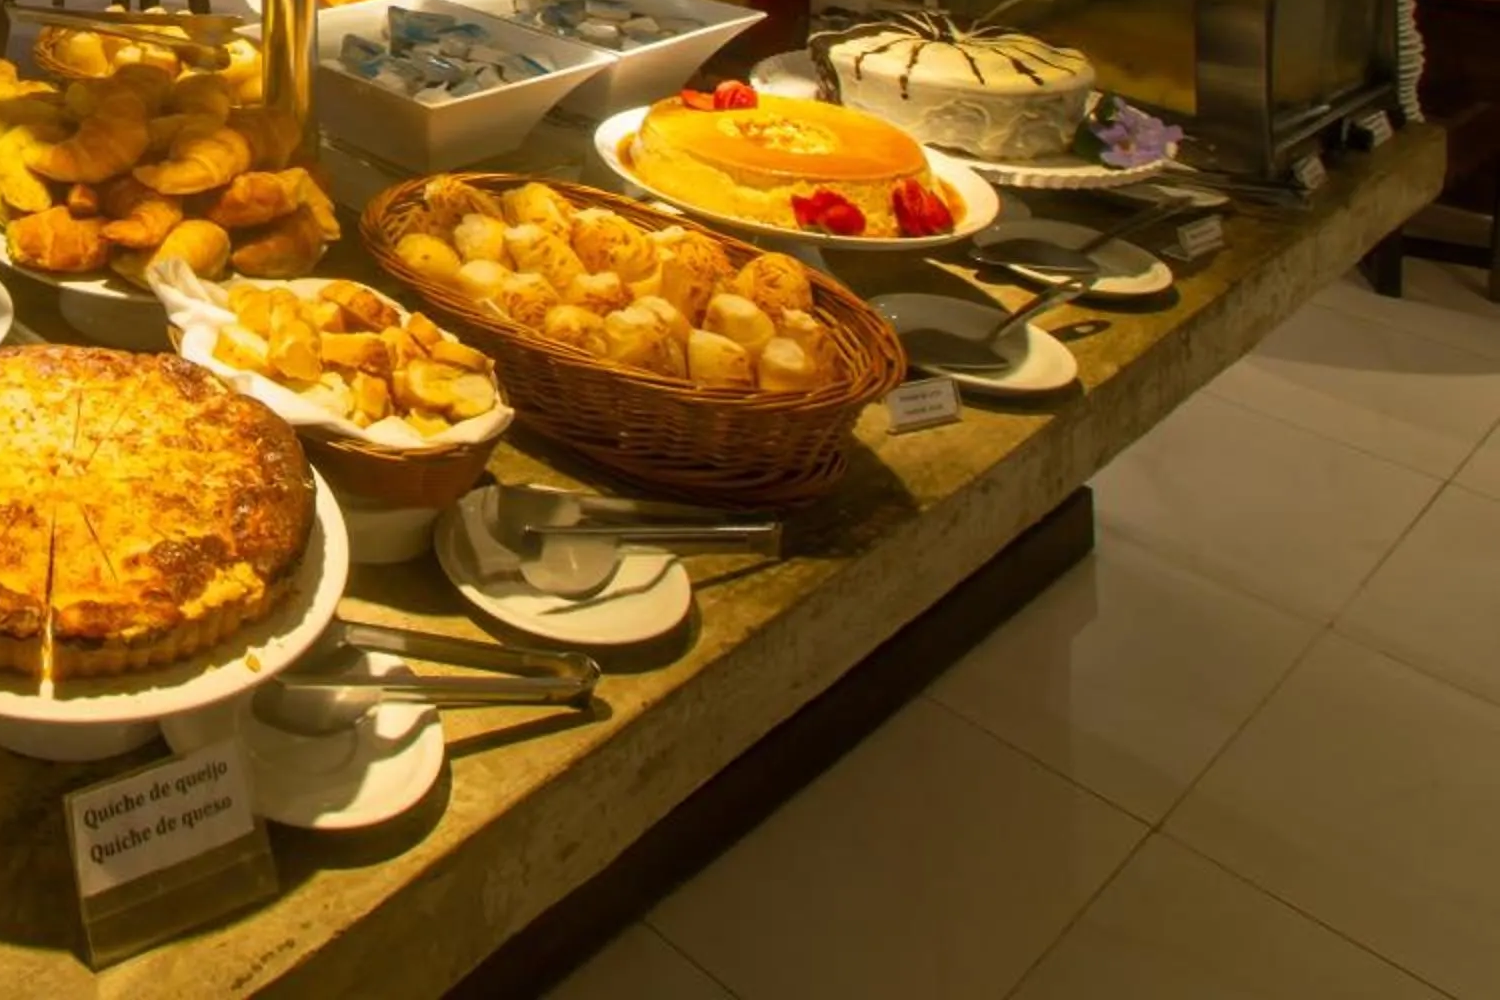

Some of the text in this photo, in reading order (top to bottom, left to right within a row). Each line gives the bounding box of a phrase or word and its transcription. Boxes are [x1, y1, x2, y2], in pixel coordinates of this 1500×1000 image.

[83, 760, 229, 830] Quiche de queijo
[89, 796, 233, 865] Quiche de queso
